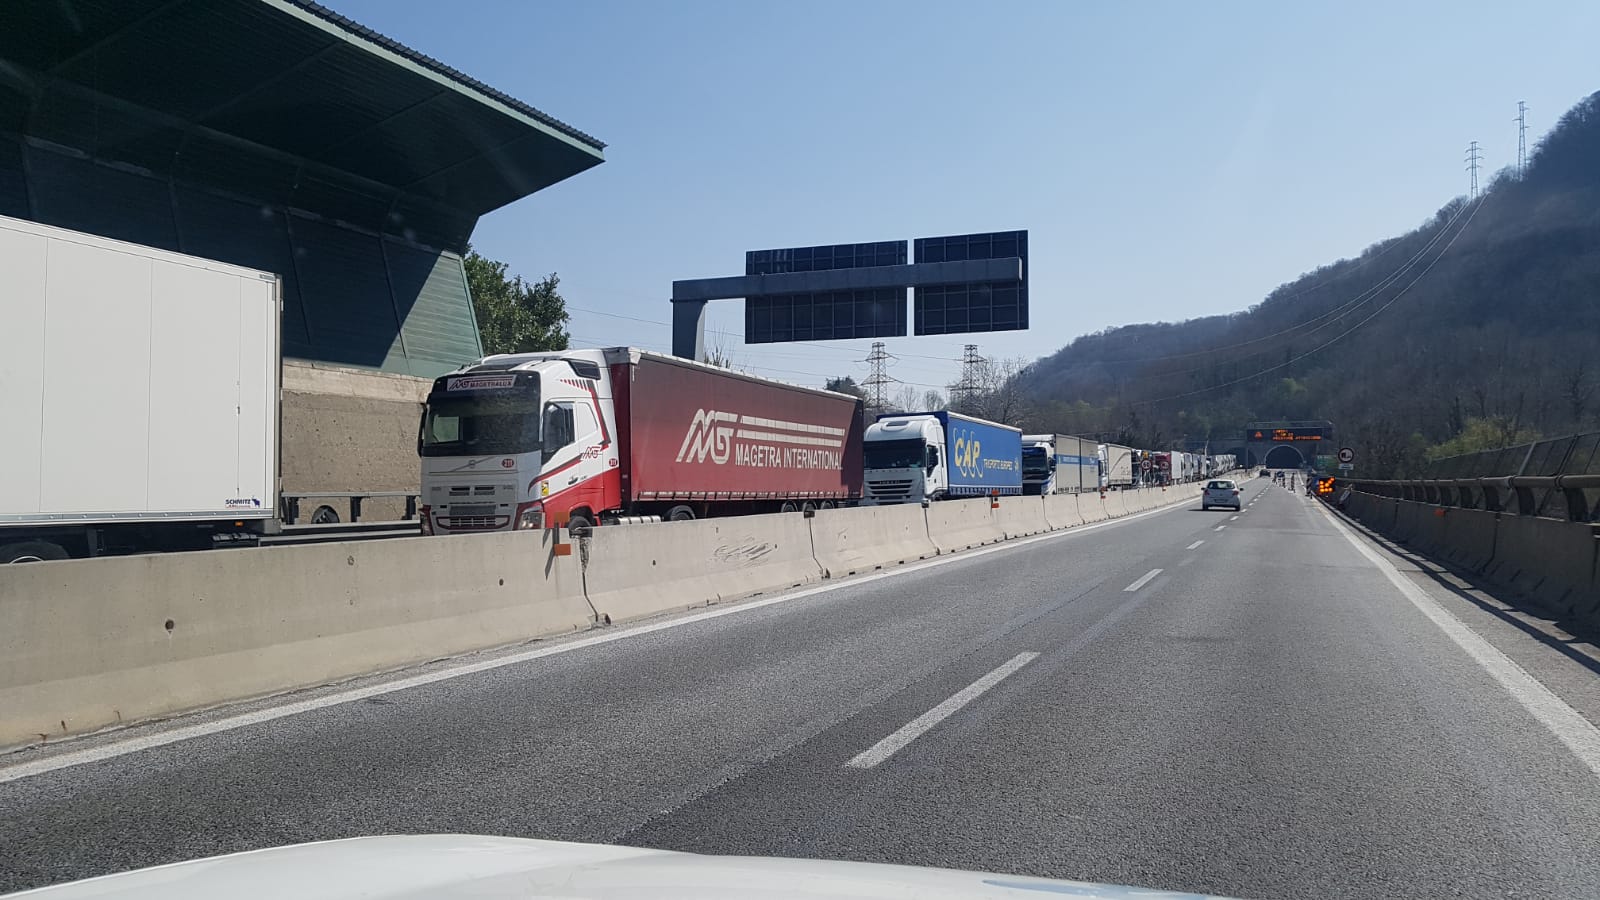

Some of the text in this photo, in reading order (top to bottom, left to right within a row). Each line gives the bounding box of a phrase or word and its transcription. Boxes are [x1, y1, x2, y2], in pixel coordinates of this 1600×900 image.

[735, 443, 843, 470] MAGETRA INTERNATIONAL
[954, 437, 981, 468] CAP
